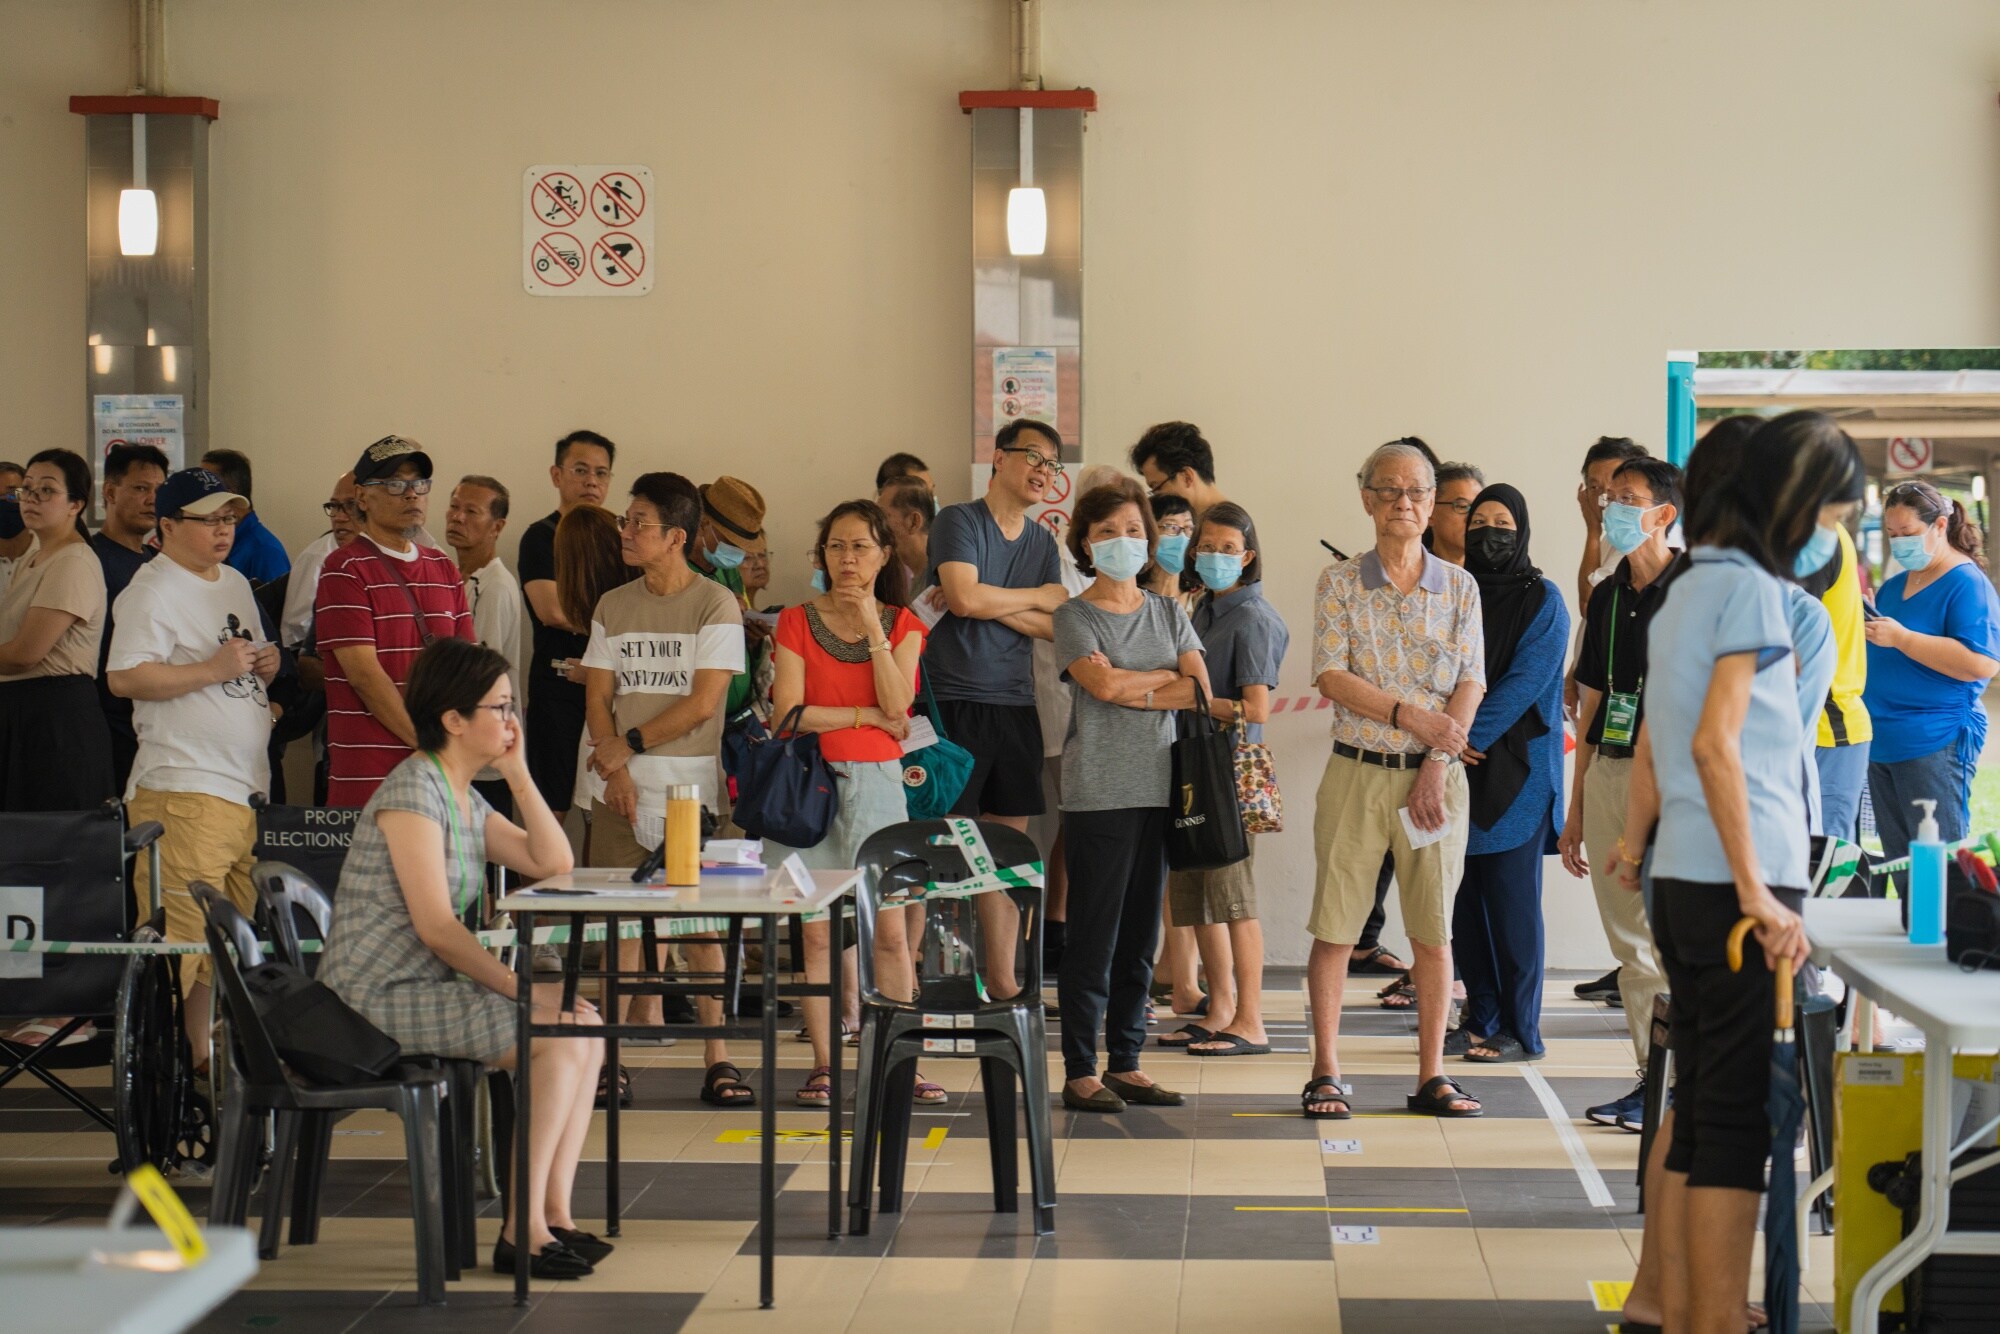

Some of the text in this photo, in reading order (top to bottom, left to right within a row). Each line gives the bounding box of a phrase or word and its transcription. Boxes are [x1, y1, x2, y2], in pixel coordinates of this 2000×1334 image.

[620, 640, 682, 658] SET YOUR
[264, 831, 353, 847] ELECTIONS
